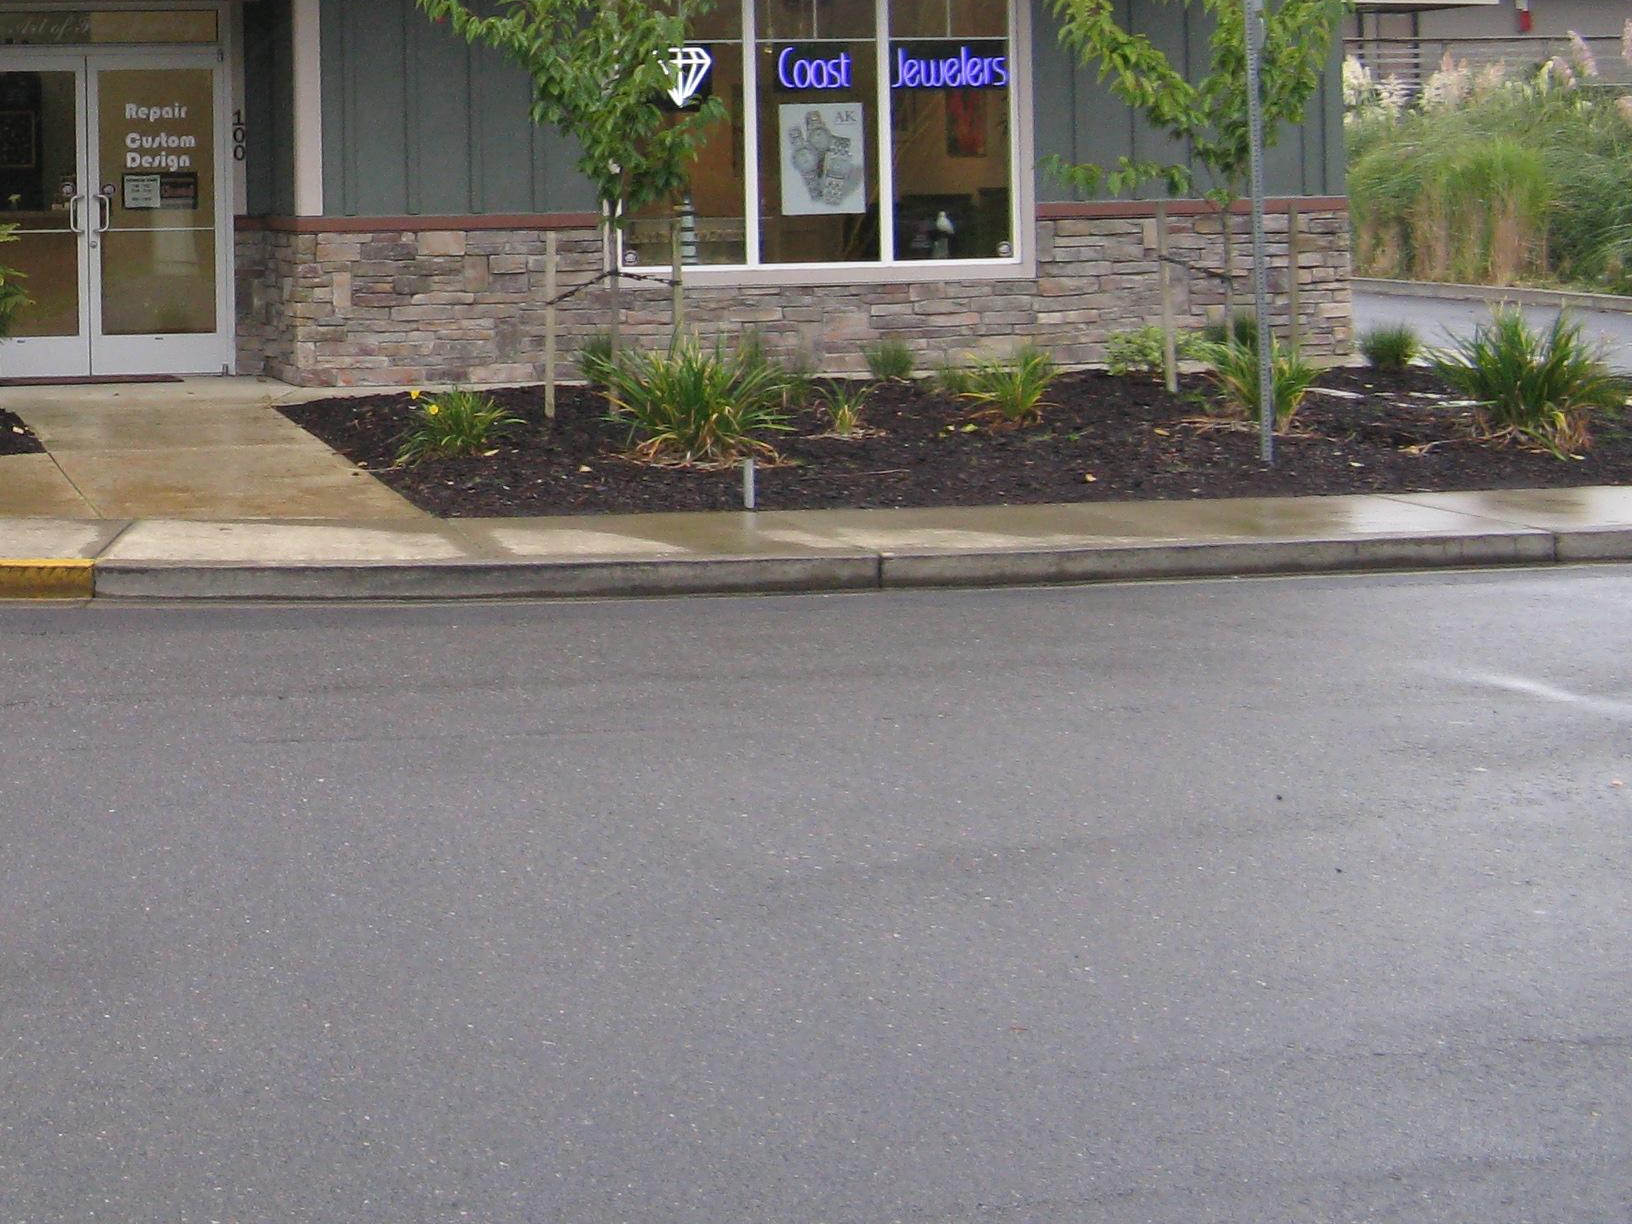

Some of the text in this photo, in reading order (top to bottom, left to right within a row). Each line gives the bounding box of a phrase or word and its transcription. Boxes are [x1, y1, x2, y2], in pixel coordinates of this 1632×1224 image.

[50, 12, 76, 40] of
[778, 45, 1007, 88] Coast Jewelers
[125, 102, 188, 122] Repair
[834, 110, 857, 123] AK
[125, 131, 197, 149] Custom
[232, 108, 246, 161] 100
[126, 150, 191, 172] Design
